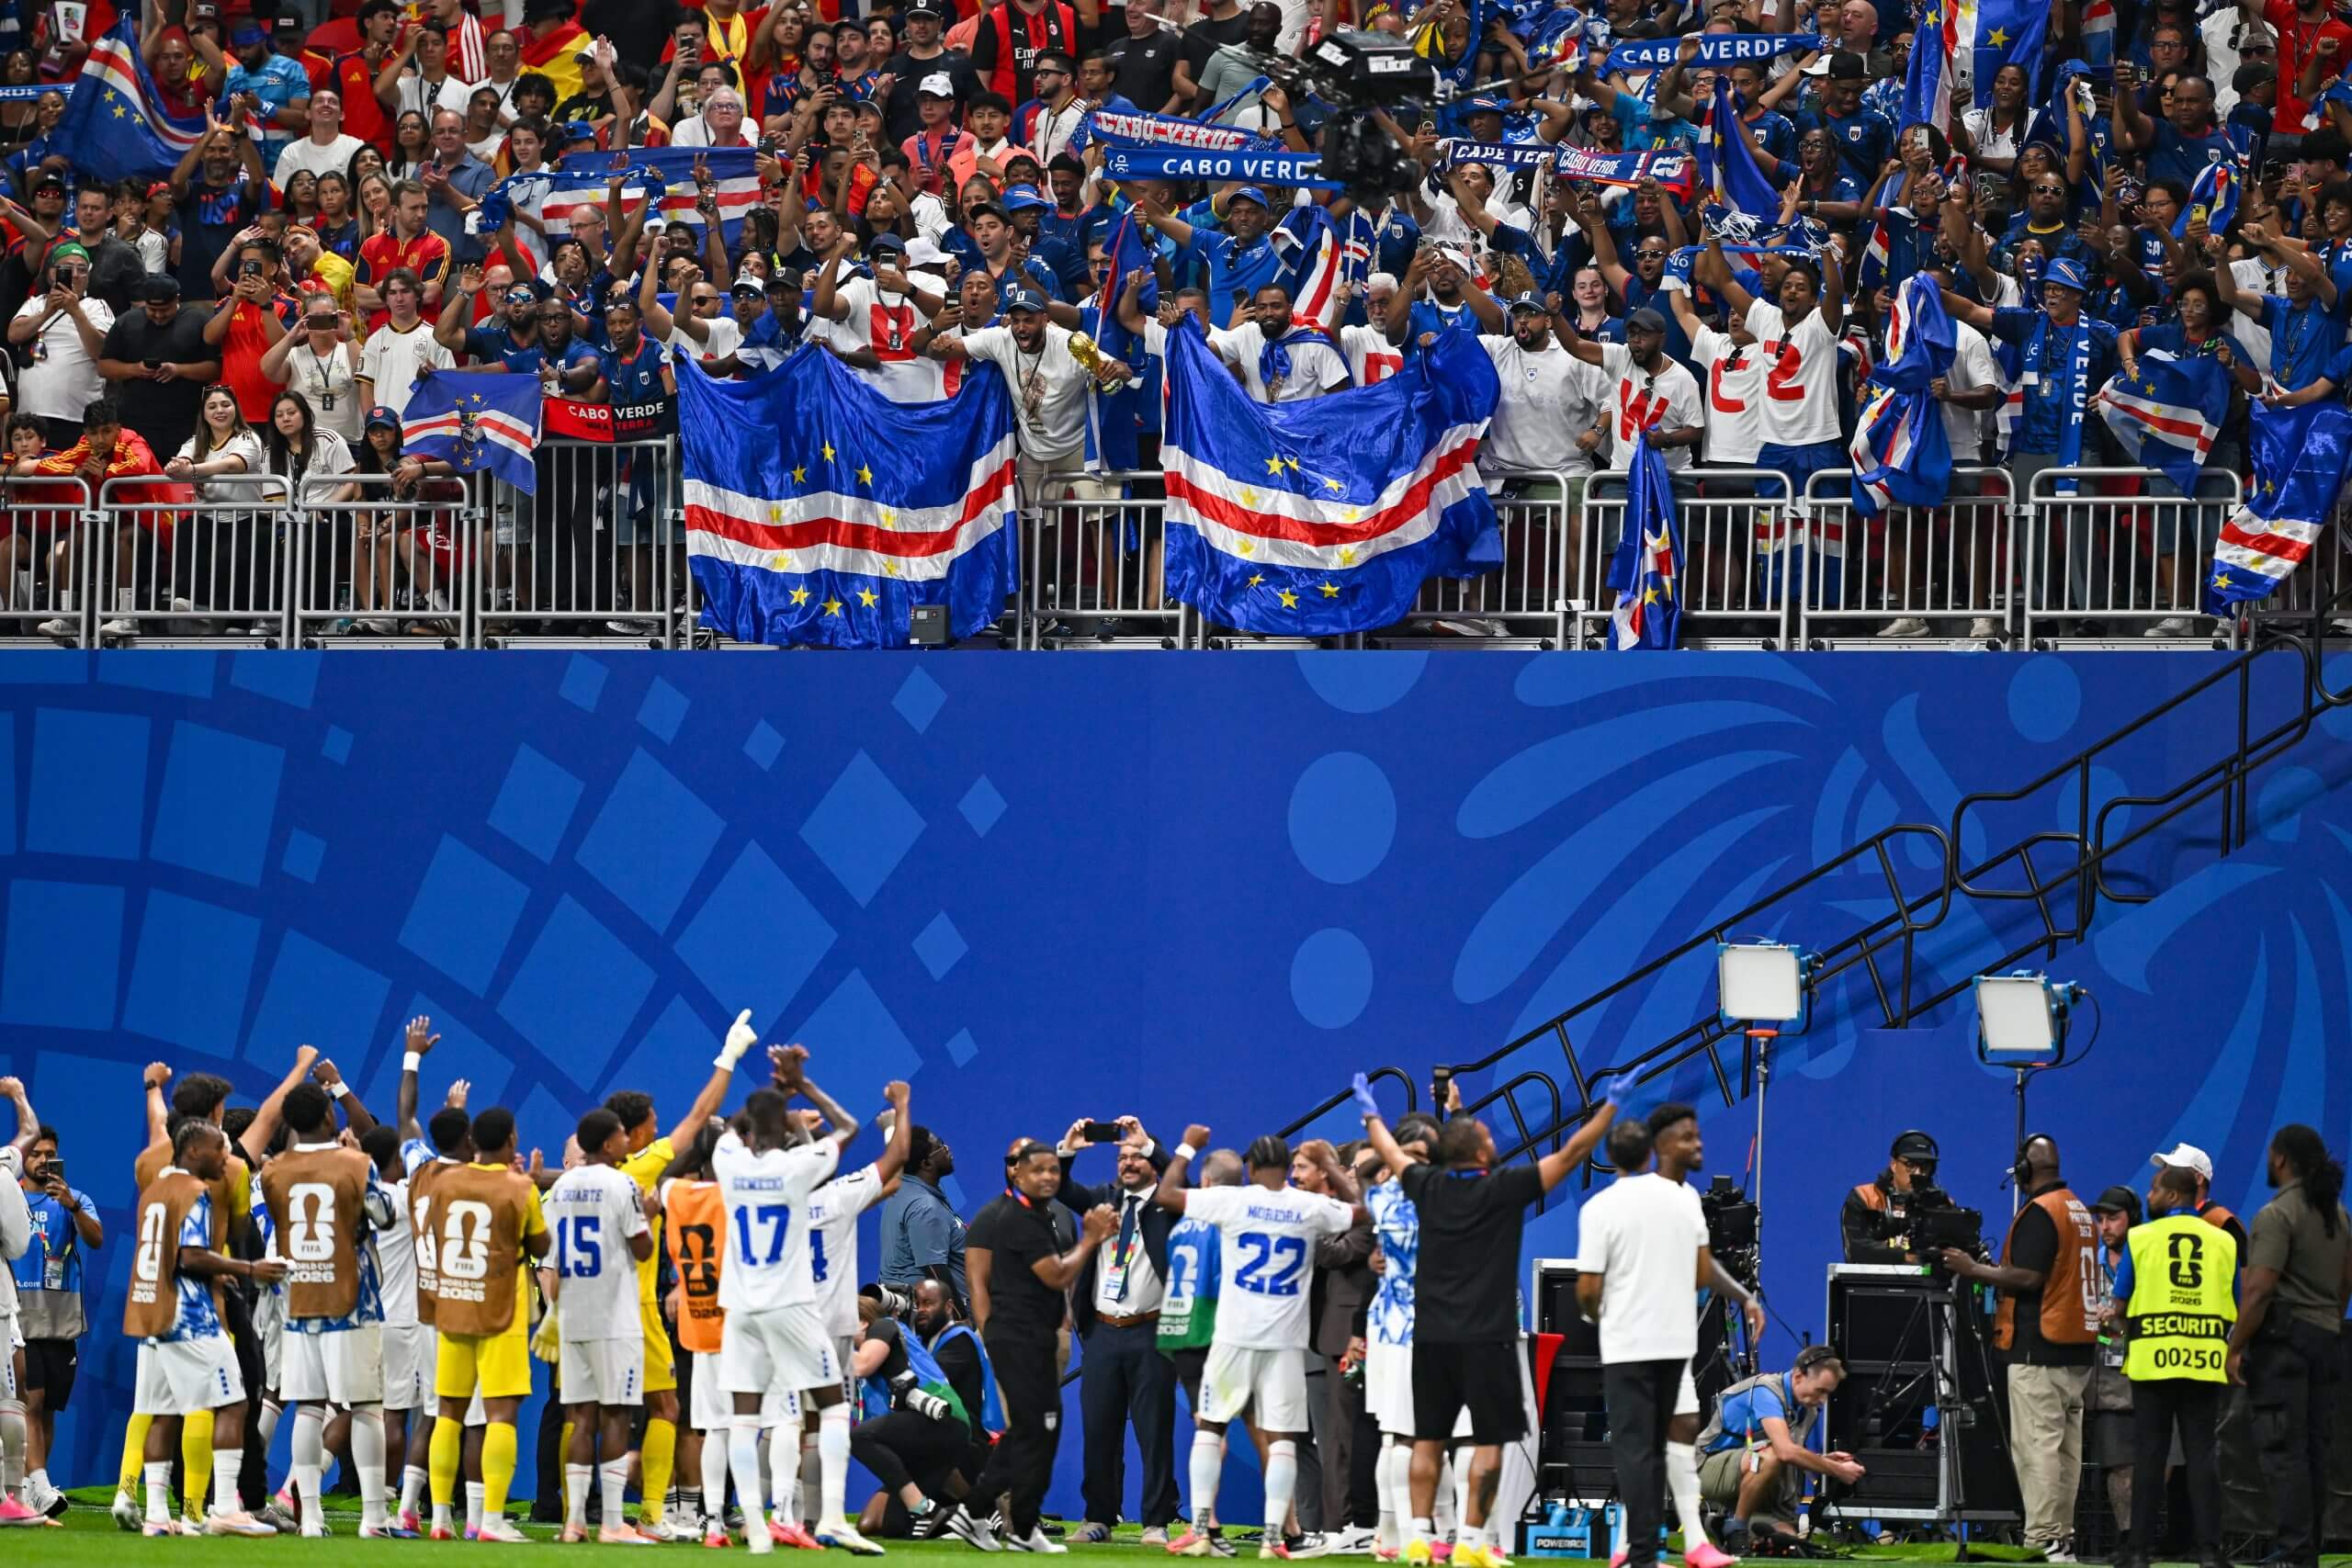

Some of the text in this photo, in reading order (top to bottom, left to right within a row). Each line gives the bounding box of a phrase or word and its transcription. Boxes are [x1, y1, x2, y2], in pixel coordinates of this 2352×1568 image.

[1102, 112, 1244, 151] CABO VERDE
[1455, 145, 1507, 160] CAPE
[1163, 158, 1326, 180] CABO VERD
[1559, 151, 1589, 170] CABO
[1588, 157, 1622, 175] VERDE
[199, 193, 240, 225] USA
[568, 402, 664, 420] CABO VERDE
[616, 419, 653, 431] TERRA
[735, 1203, 790, 1266] 17
[301, 1245, 322, 1253] FIFA
[558, 1215, 602, 1279] 15
[296, 1263, 317, 1271] ORLD
[455, 1261, 475, 1272] FIFA
[1235, 1232, 1306, 1295] 22
[289, 1270, 335, 1283] 2026
[2177, 1276, 2194, 1285] FIFA
[437, 1286, 486, 1303] 2026
[2170, 1295, 2202, 1306] 2026
[1167, 1300, 1185, 1309] FIFA
[2154, 1347, 2222, 1370] 00250
